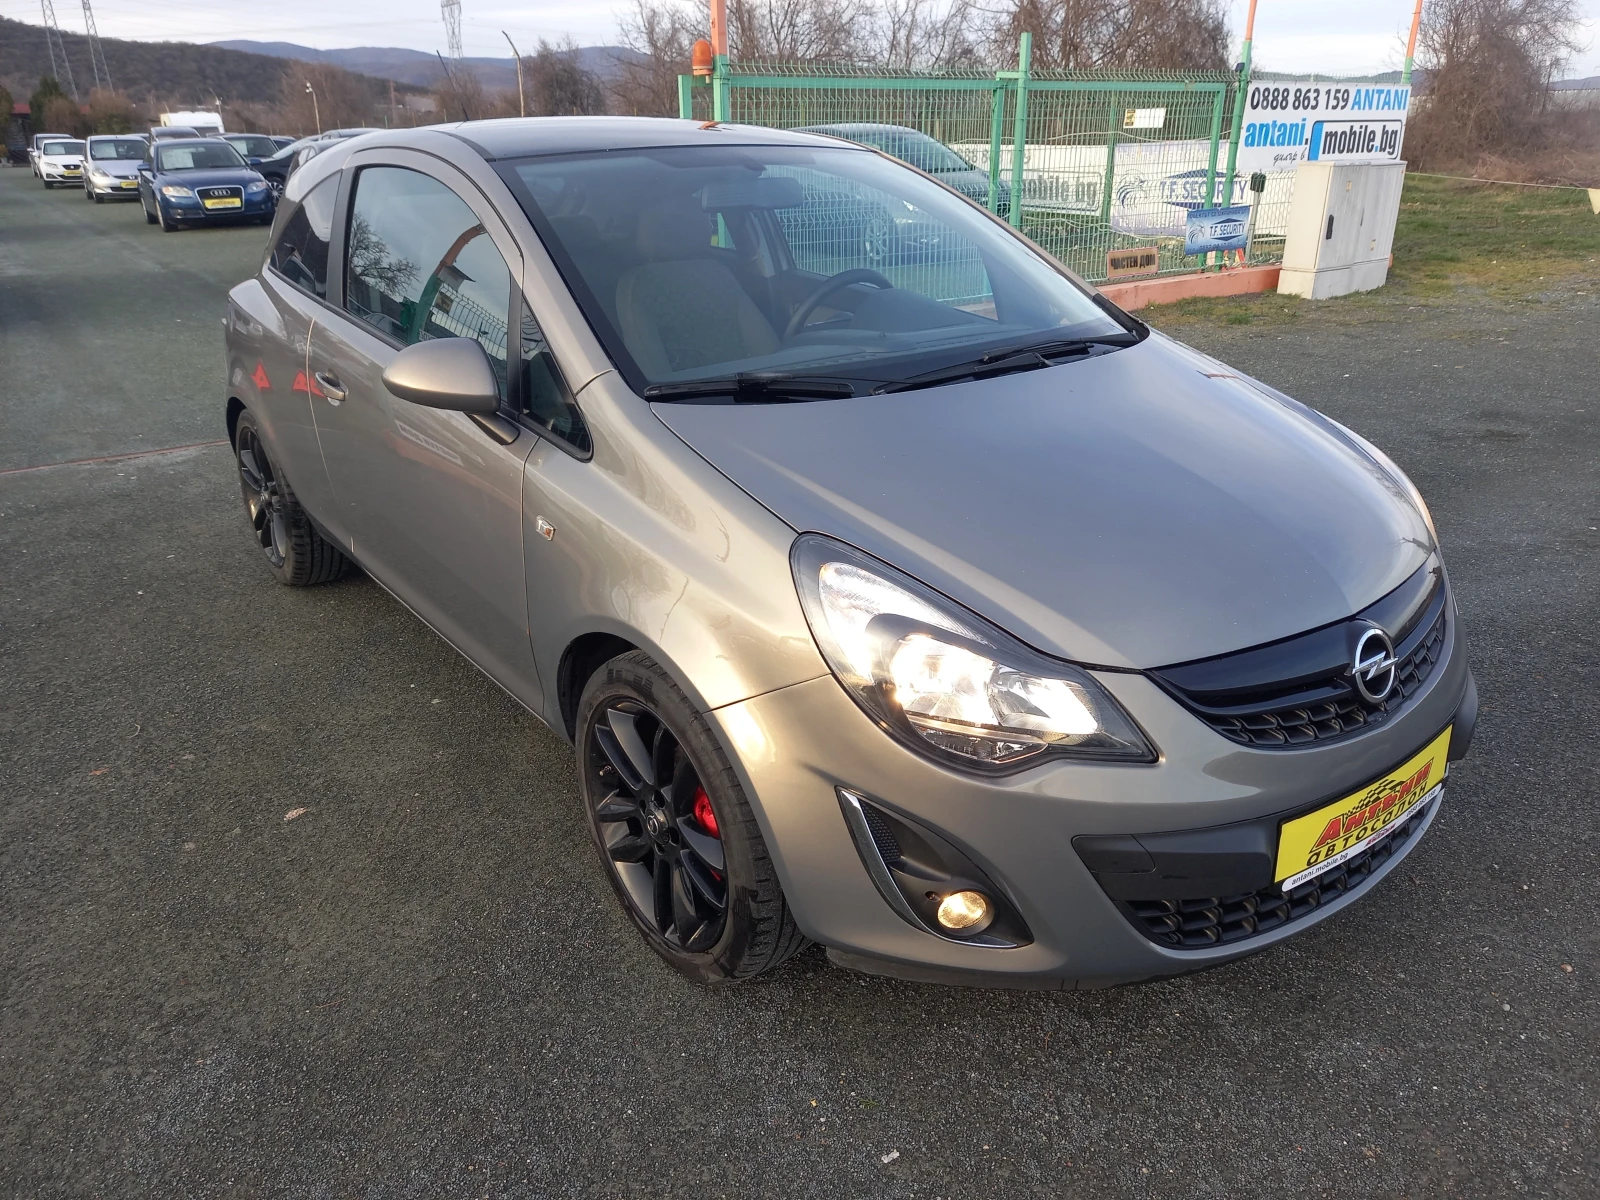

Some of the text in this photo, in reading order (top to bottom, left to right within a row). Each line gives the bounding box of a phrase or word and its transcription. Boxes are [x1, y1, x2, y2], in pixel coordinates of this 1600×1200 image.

[1250, 87, 1409, 110] 0888 863 159 ANTANI
[1322, 124, 1399, 155] mobile.bg
[1182, 180, 1248, 200] SECRTY
[1219, 223, 1246, 236] SECURITY
[1110, 254, 1156, 270] ЧАСТЕН ДОМ
[1291, 852, 1349, 885] antani.mobile.bg
